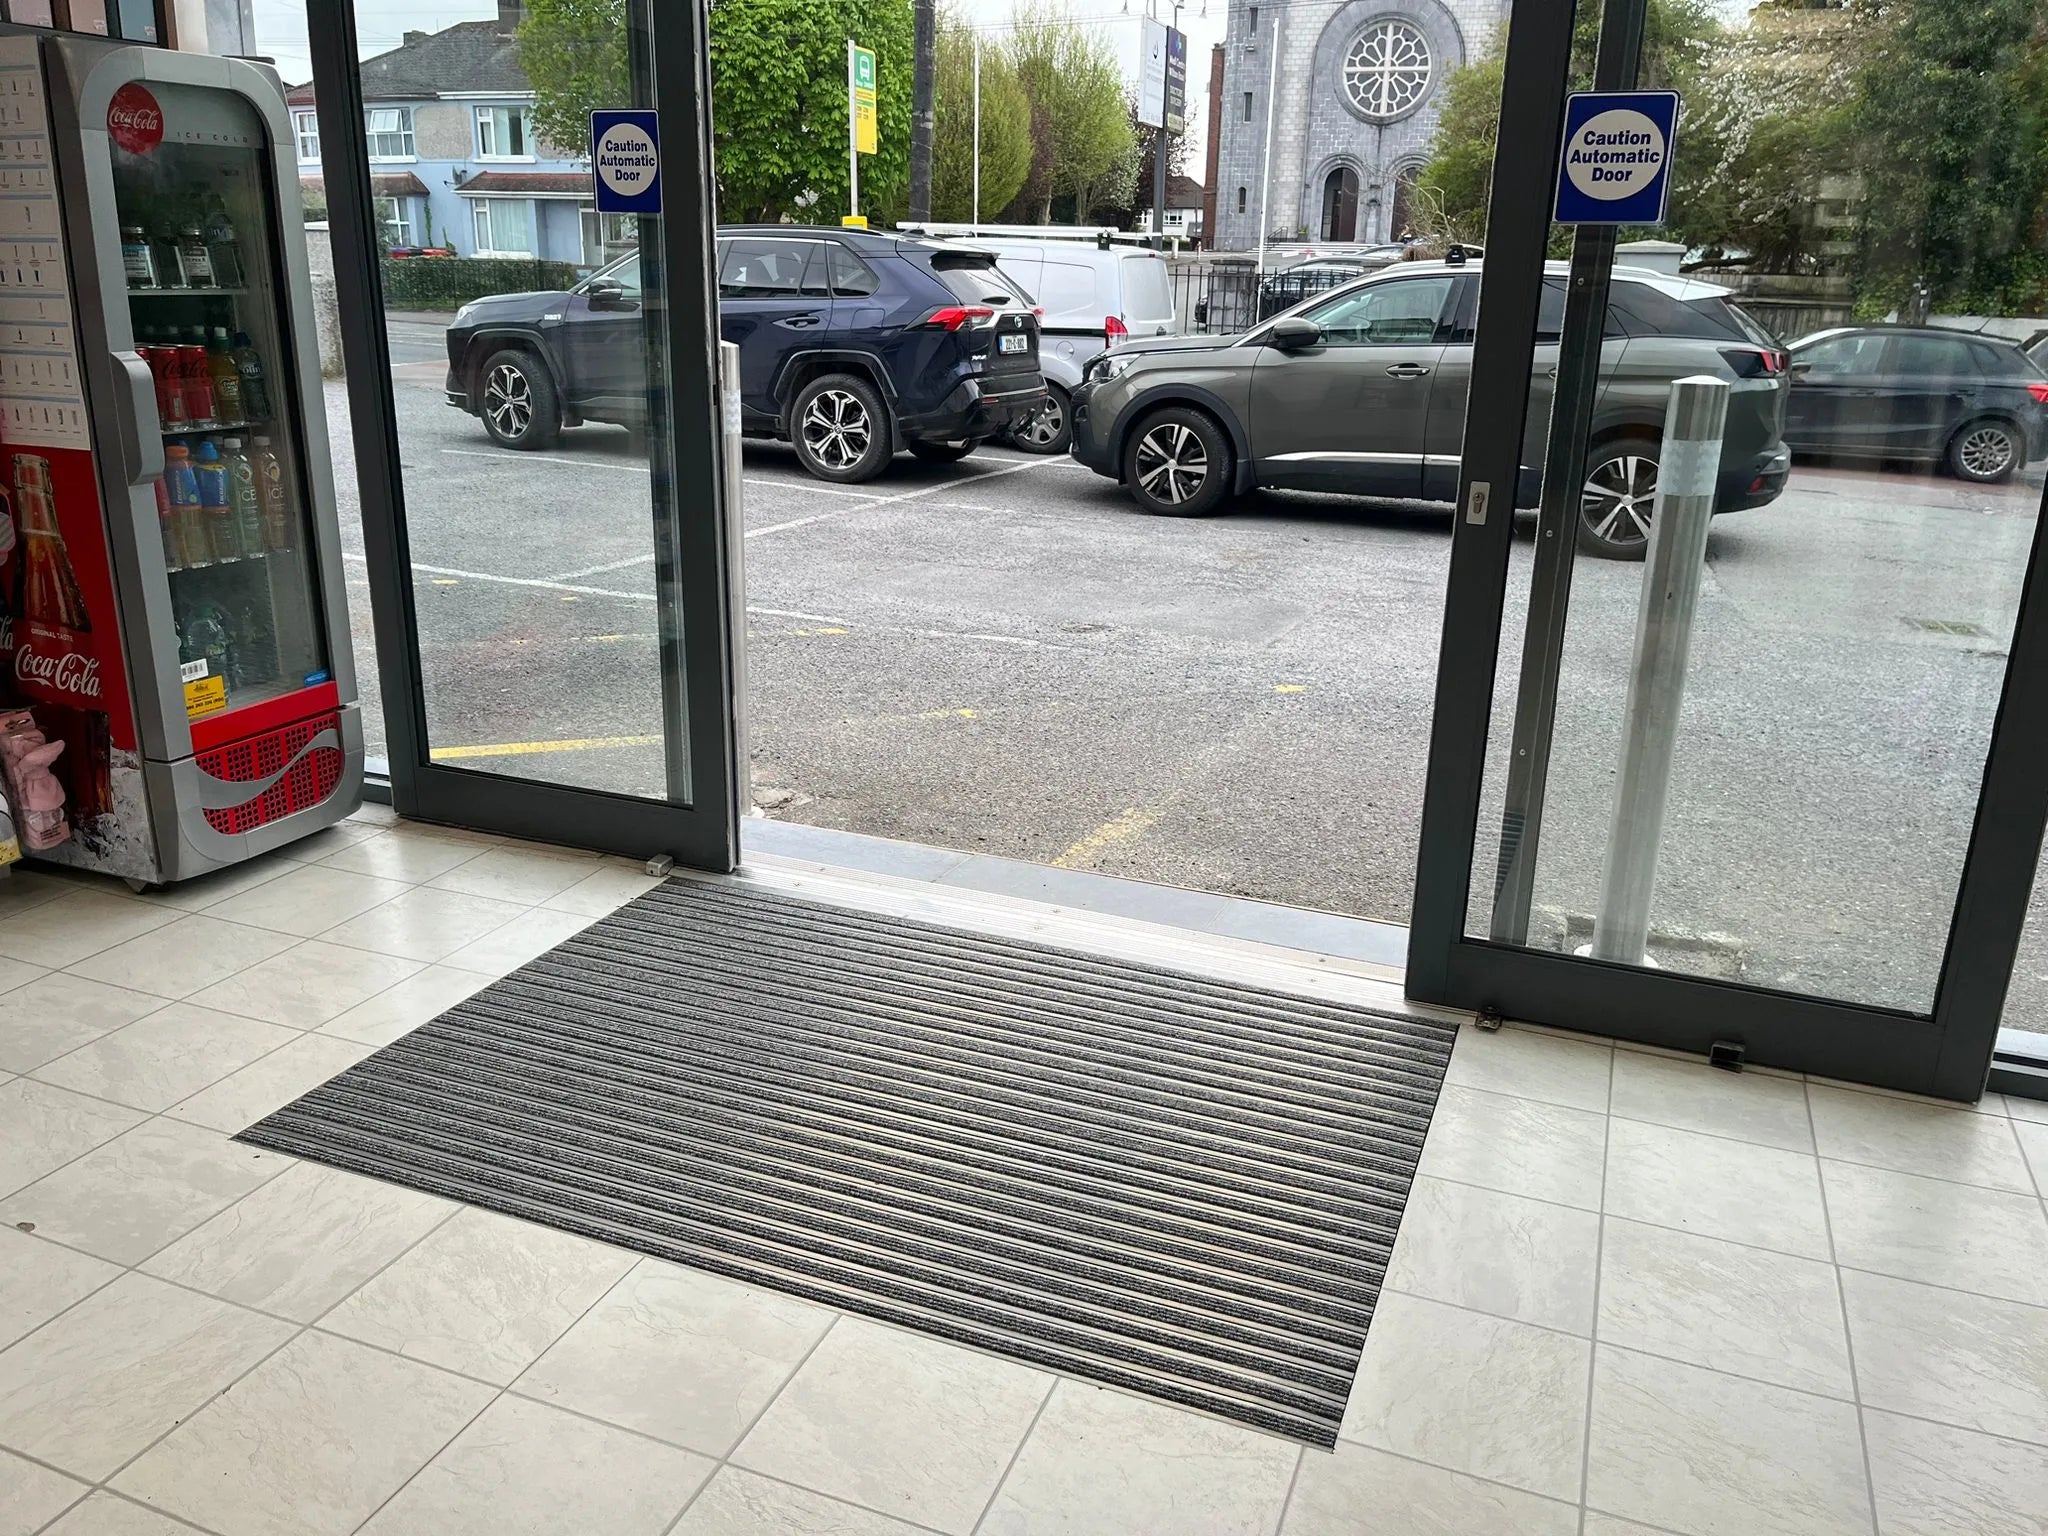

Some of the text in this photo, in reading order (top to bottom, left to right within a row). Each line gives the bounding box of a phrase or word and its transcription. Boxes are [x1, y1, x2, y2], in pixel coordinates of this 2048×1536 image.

[109, 106, 159, 130] Coca-Cola
[177, 131, 248, 143] ICE COLD
[1583, 129, 1651, 146] Caution
[605, 140, 648, 152] Caution
[600, 154, 656, 167] Automatic
[1569, 148, 1660, 164] Automatic
[615, 169, 641, 181] Door
[1591, 167, 1633, 182] Door
[15, 643, 101, 697] Coca-Cola
